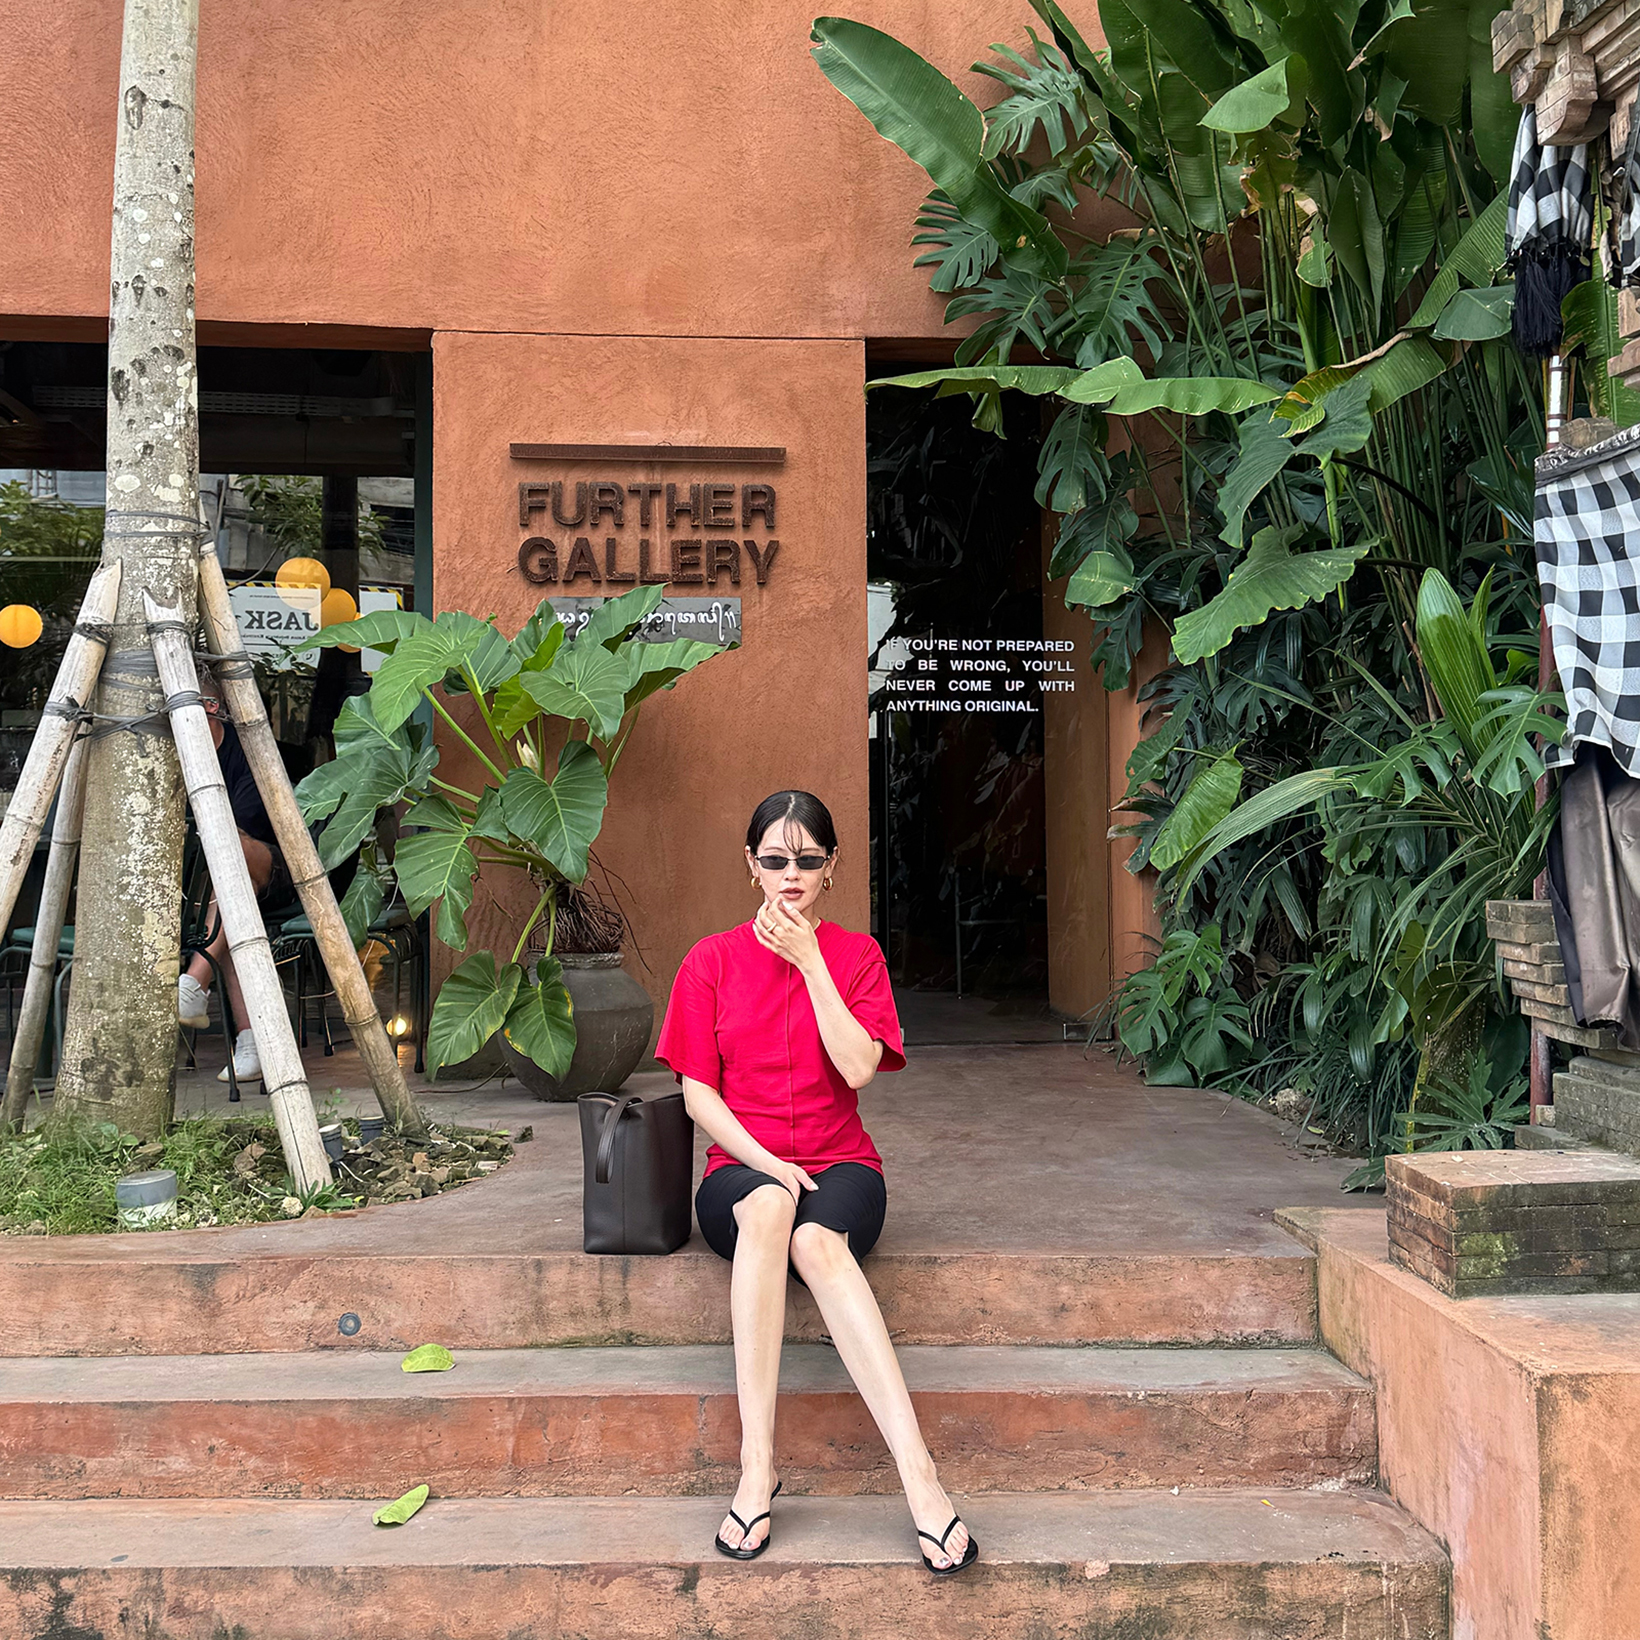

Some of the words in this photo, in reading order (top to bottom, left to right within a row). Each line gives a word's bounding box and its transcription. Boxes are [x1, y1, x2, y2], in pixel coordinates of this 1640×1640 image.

[519, 481, 777, 527] FURTHER
[518, 536, 780, 585] GALLERY
[903, 639, 958, 651] YOU'RE
[961, 640, 992, 651] NOT
[996, 640, 1075, 652] PREPARED
[918, 659, 938, 670] BE
[950, 660, 1011, 673] WRONG,
[1022, 660, 1075, 672] YOU'LL
[885, 680, 936, 691] NEVER
[948, 680, 992, 691] COME
[1005, 680, 1025, 691] UP
[1038, 680, 1075, 692] WITH
[886, 700, 962, 712] ANYTHING
[964, 700, 1039, 712] ORIGINAL.
